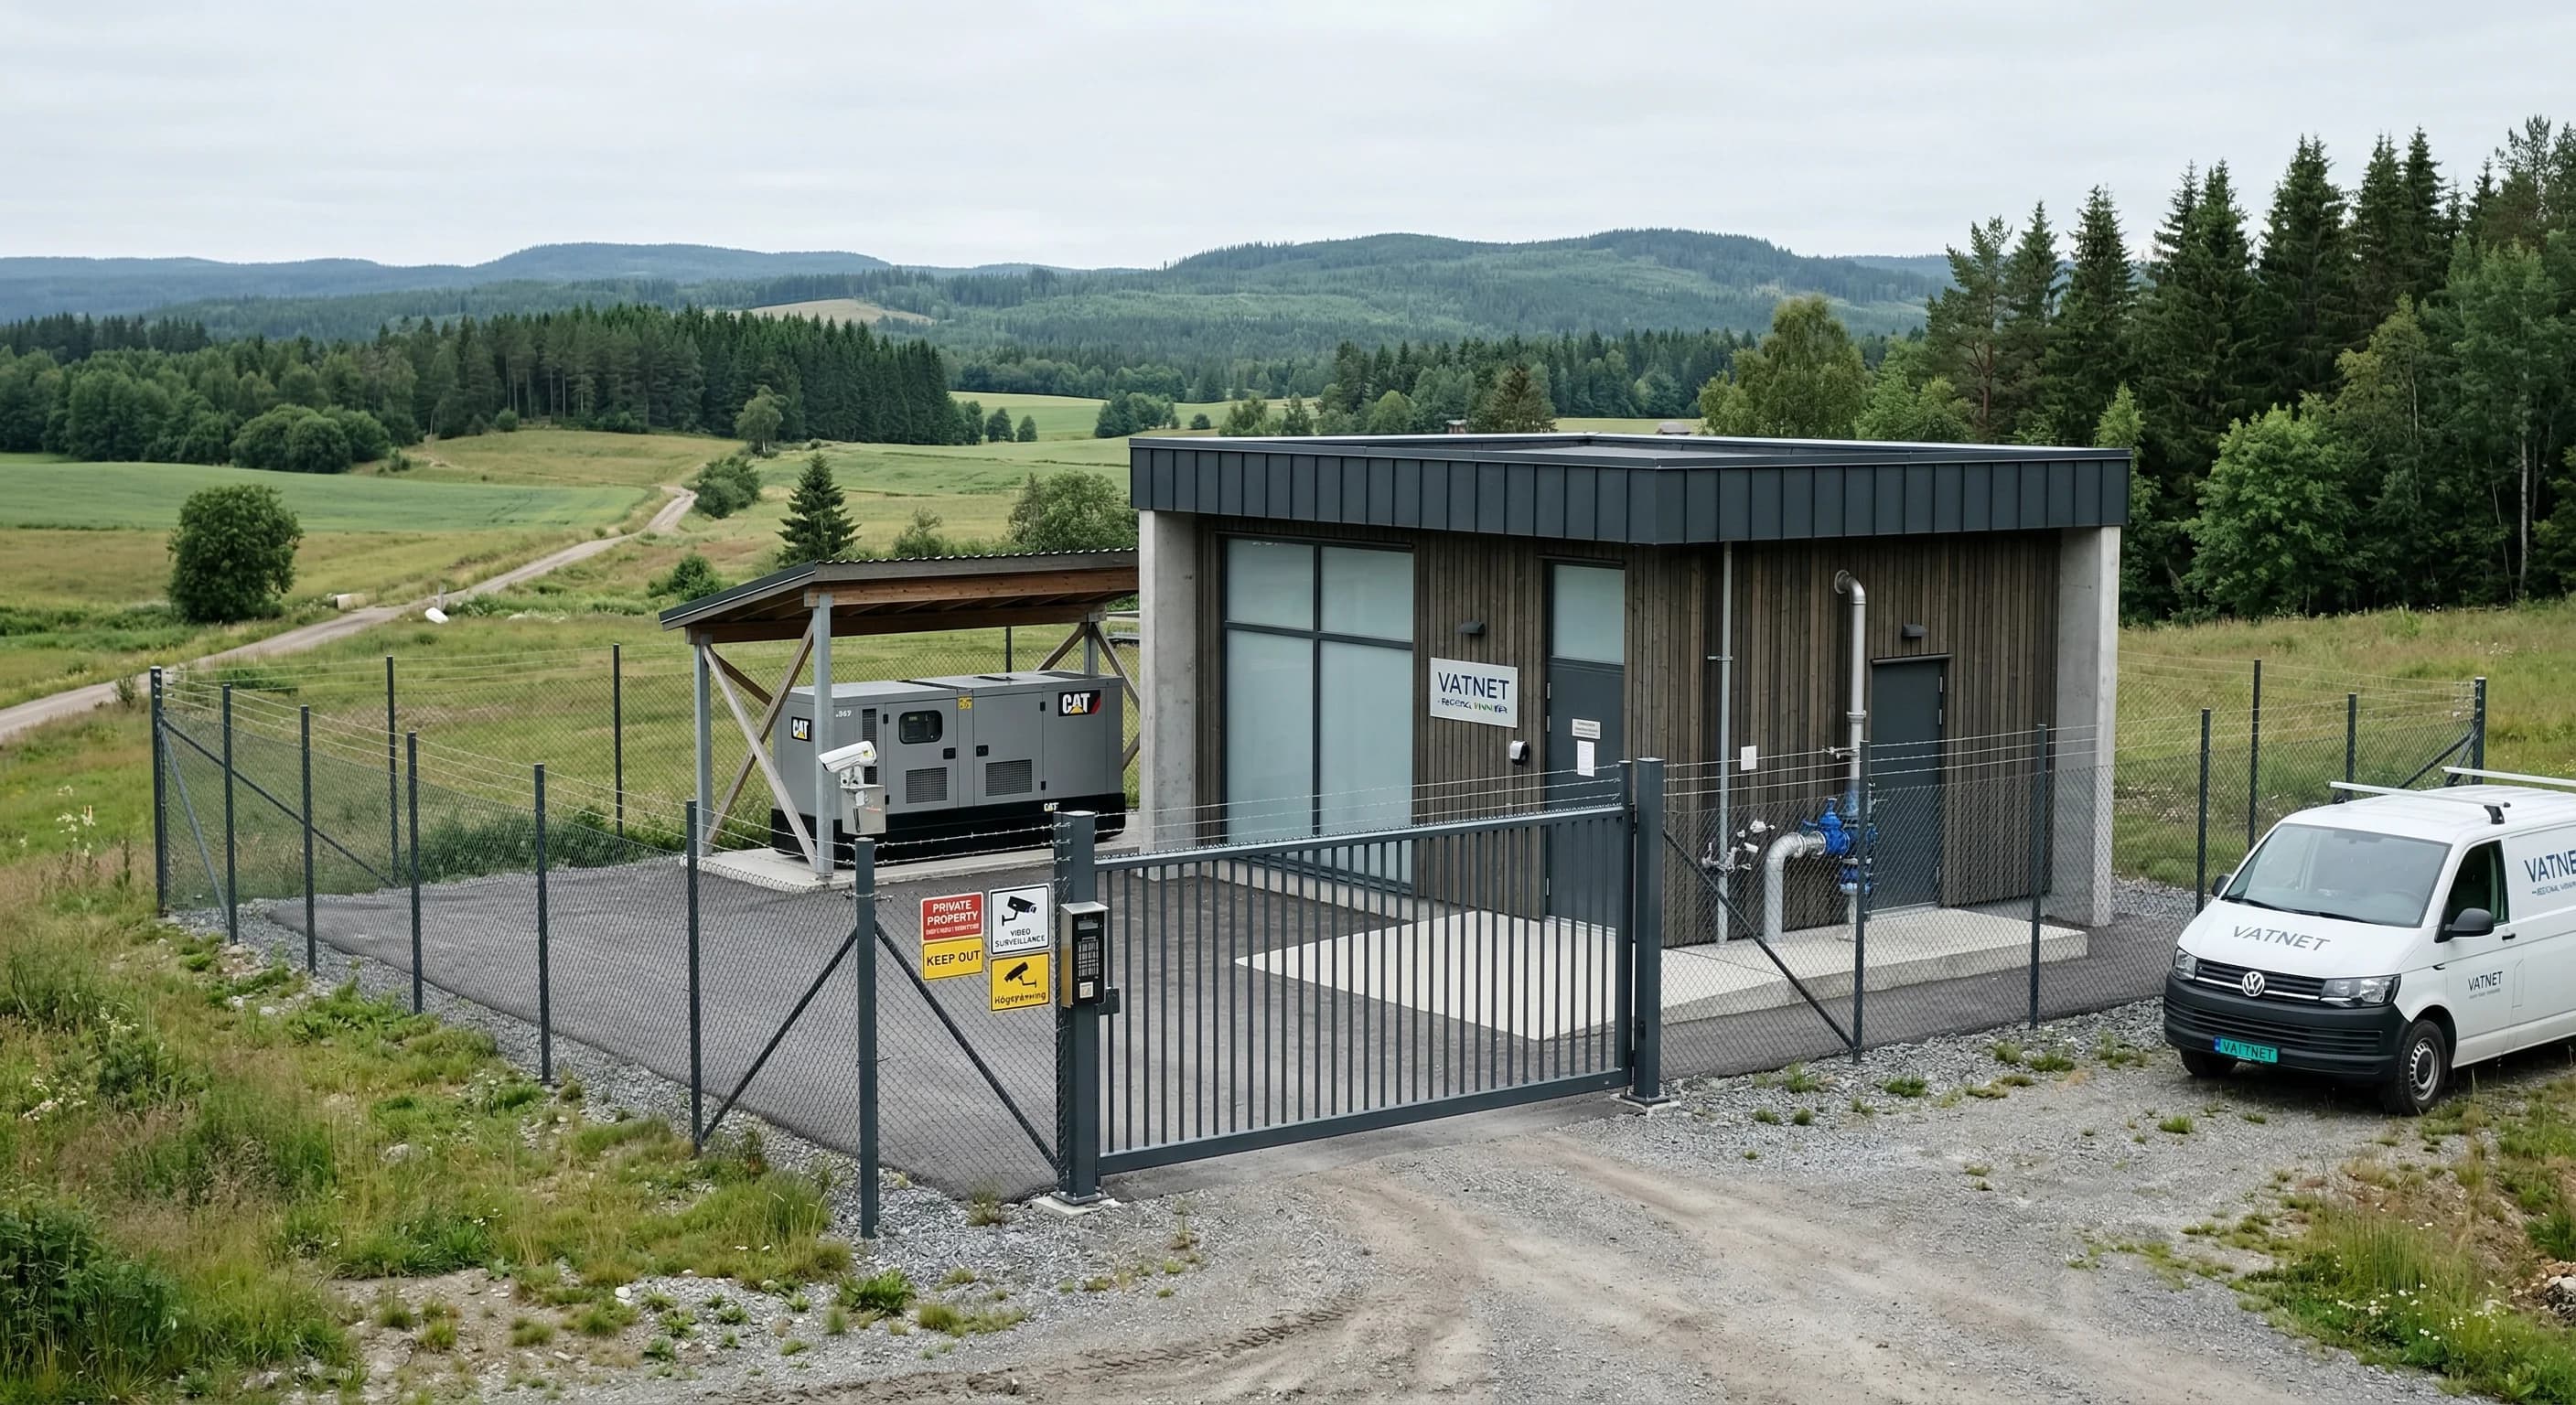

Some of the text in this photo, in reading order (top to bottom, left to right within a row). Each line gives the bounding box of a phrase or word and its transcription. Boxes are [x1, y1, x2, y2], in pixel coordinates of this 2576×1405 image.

[1438, 671, 1509, 700] VATNET
[1062, 692, 1090, 713] CAT
[792, 718, 809, 739] CAT
[1044, 802, 1059, 811] CAT
[933, 900, 971, 913] PRIVATE
[927, 910, 978, 926] PROPERTY
[995, 935, 1046, 948] SURVEILLANCE
[2234, 926, 2331, 950] VATNET
[927, 950, 981, 967] KEEP OUT
[2467, 971, 2503, 992] VATNET
